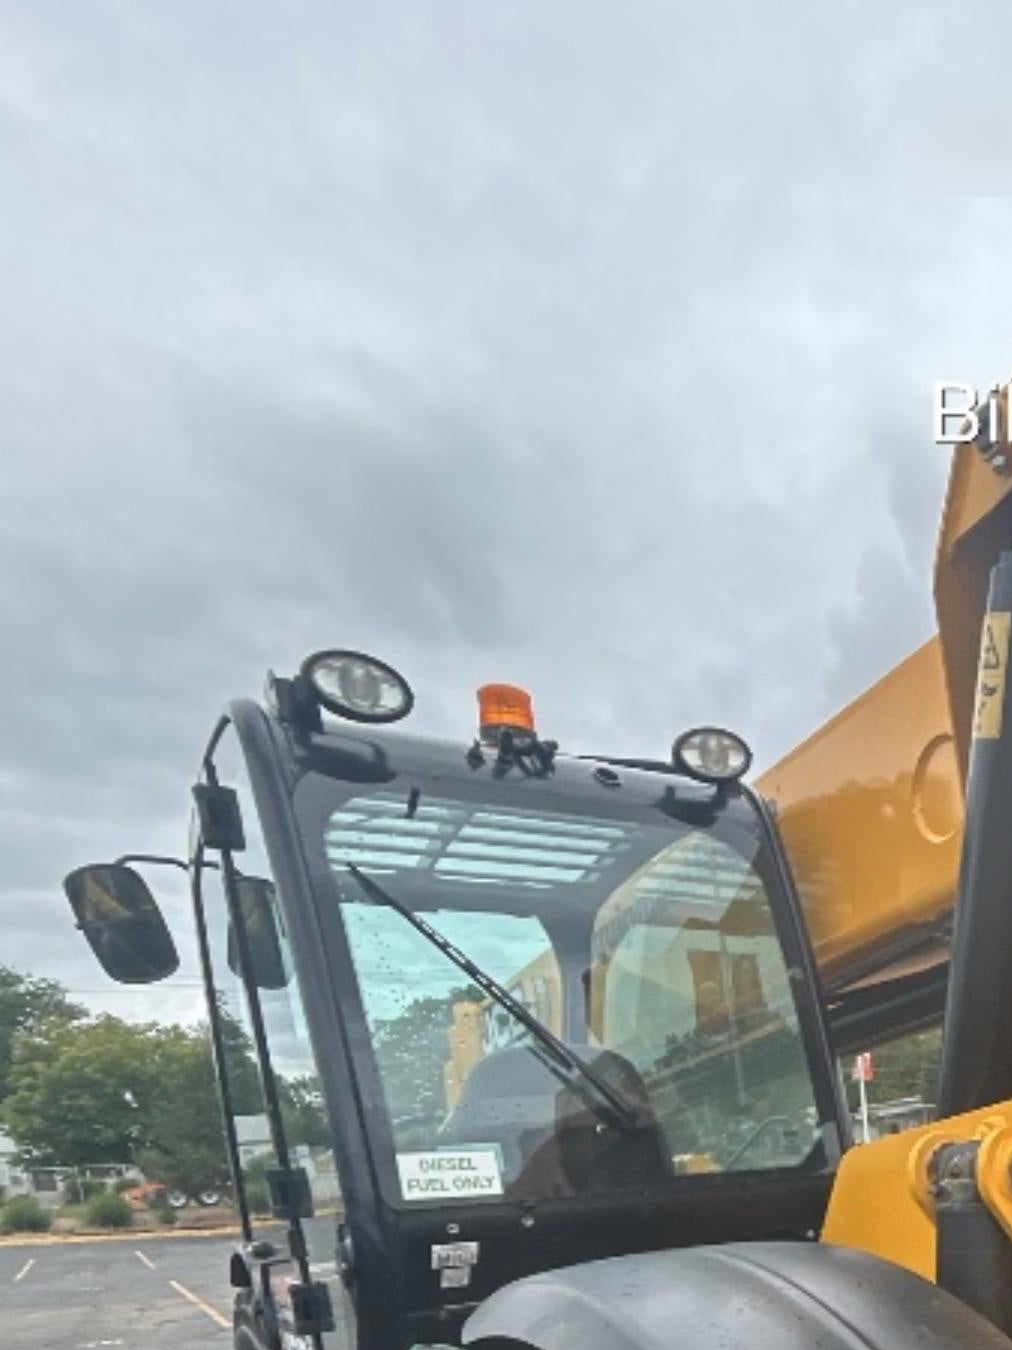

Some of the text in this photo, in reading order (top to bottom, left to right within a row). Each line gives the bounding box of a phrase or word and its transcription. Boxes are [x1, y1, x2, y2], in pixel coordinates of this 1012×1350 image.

[419, 1157, 477, 1173] DIESEL
[407, 1175, 495, 1193] FUEL ONLY
